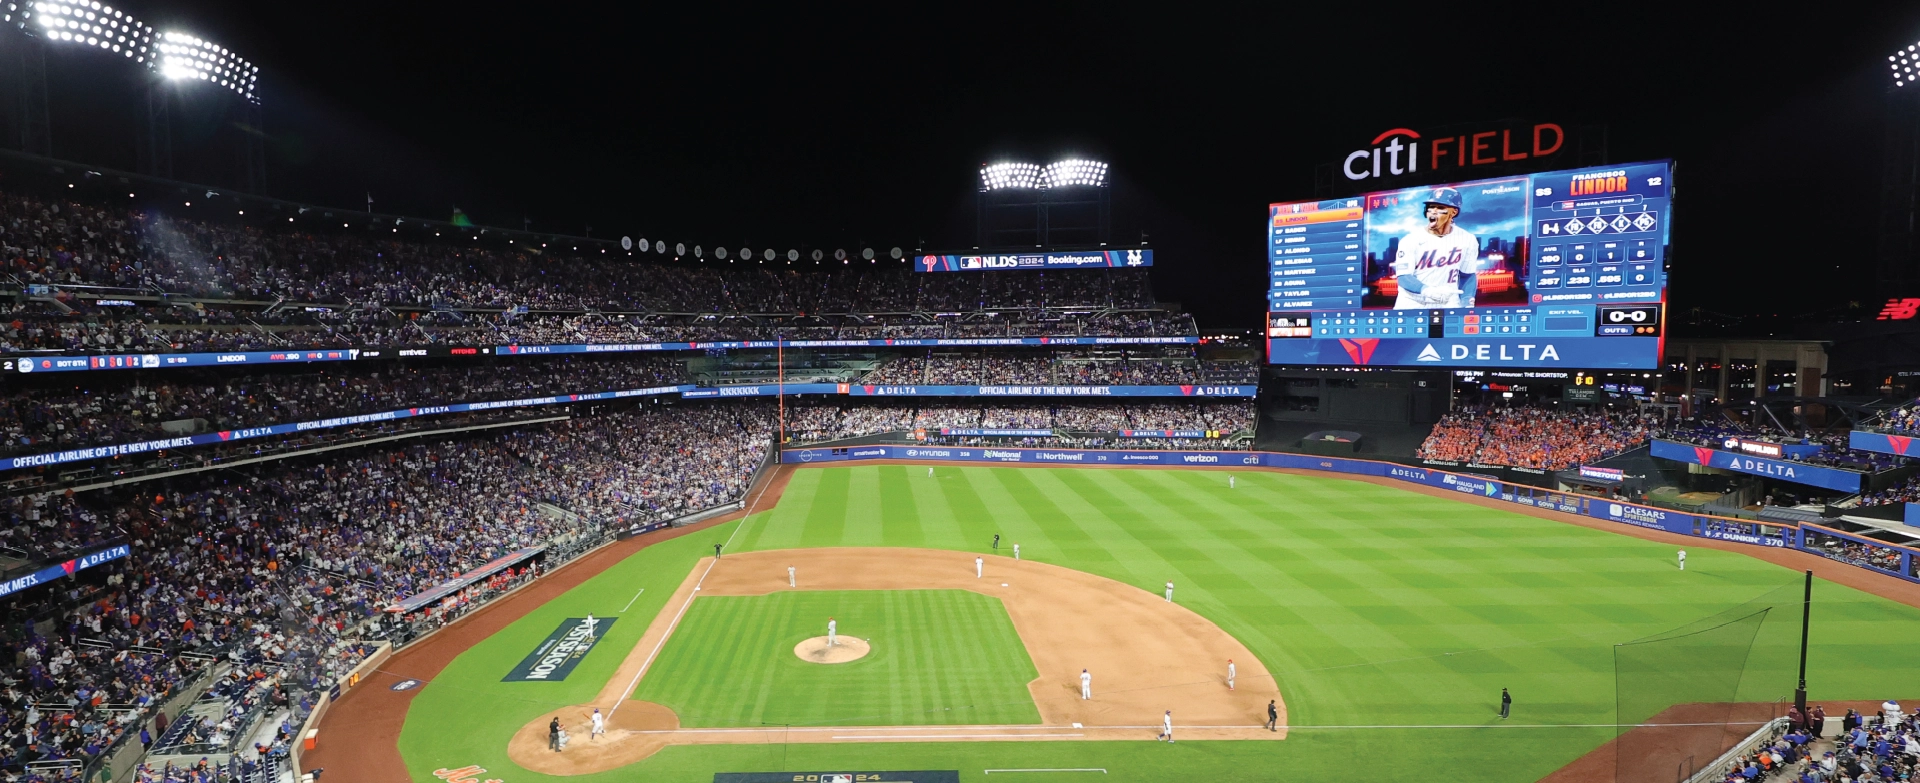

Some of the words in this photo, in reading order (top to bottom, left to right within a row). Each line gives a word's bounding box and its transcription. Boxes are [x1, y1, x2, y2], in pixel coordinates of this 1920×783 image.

[1343, 136, 1418, 180] citi
[1431, 123, 1564, 170] FIELD
[1572, 170, 1626, 181] FRANCISCO
[1570, 176, 1628, 196] LINDOR
[1647, 177, 1662, 186] 12
[1482, 186, 1520, 195] POSTSEASON
[1535, 187, 1552, 196] SS
[1542, 223, 1560, 235] 0-4
[982, 256, 1018, 267] NLDS
[1048, 255, 1102, 265] Booking.com
[1415, 246, 1462, 271] Mets
[1539, 255, 1560, 263] .190
[1447, 268, 1458, 283] 12
[1609, 310, 1647, 322] 0-0
[1451, 344, 1560, 361] DELTA
[3, 361, 13, 370] 2
[133, 357, 138, 366] 2
[840, 384, 847, 393] 7
[886, 386, 917, 395] DELTA
[979, 386, 1007, 395] OFFICIAL
[1007, 386, 1033, 395] AIRLINE
[1033, 386, 1042, 395] OF
[1043, 386, 1056, 395] THE
[1056, 386, 1072, 395] NEW
[1073, 386, 1091, 395] YORK
[1091, 386, 1111, 395] METS.
[1206, 386, 1240, 395] DELTA
[425, 406, 449, 414] DELTA
[469, 402, 489, 410] OFFICIAL
[296, 420, 321, 431] OFFICIAL
[321, 418, 341, 428] AIRLINE
[341, 417, 347, 425] OF
[348, 416, 358, 424] THE
[358, 415, 369, 423] NEW
[370, 413, 382, 421] YORK
[382, 411, 396, 420] METS.
[243, 427, 272, 437] DELTA
[13, 454, 57, 468] OFFICIAL
[58, 449, 95, 463] AIRLINE
[95, 448, 107, 457] OF
[128, 443, 148, 453] NEW
[149, 439, 171, 450] YORK
[171, 436, 194, 447] METS.
[1741, 442, 1779, 456] PAVILION
[1043, 453, 1084, 461] Northwell
[1183, 454, 1218, 463] verizon
[1243, 454, 1259, 464] citi
[1745, 460, 1795, 478] DELTA
[1399, 469, 1426, 480] DELTA
[1456, 480, 1485, 490] HAUGLAND
[1623, 513, 1658, 523] SPORTSBOOK
[1624, 506, 1666, 520] CAESARS
[1621, 518, 1641, 526] CAESARS
[1723, 532, 1760, 544] DUNKIN'
[1764, 538, 1784, 547] 370
[91, 546, 126, 564] DELTA
[1824, 552, 1863, 566] CADILLAC
